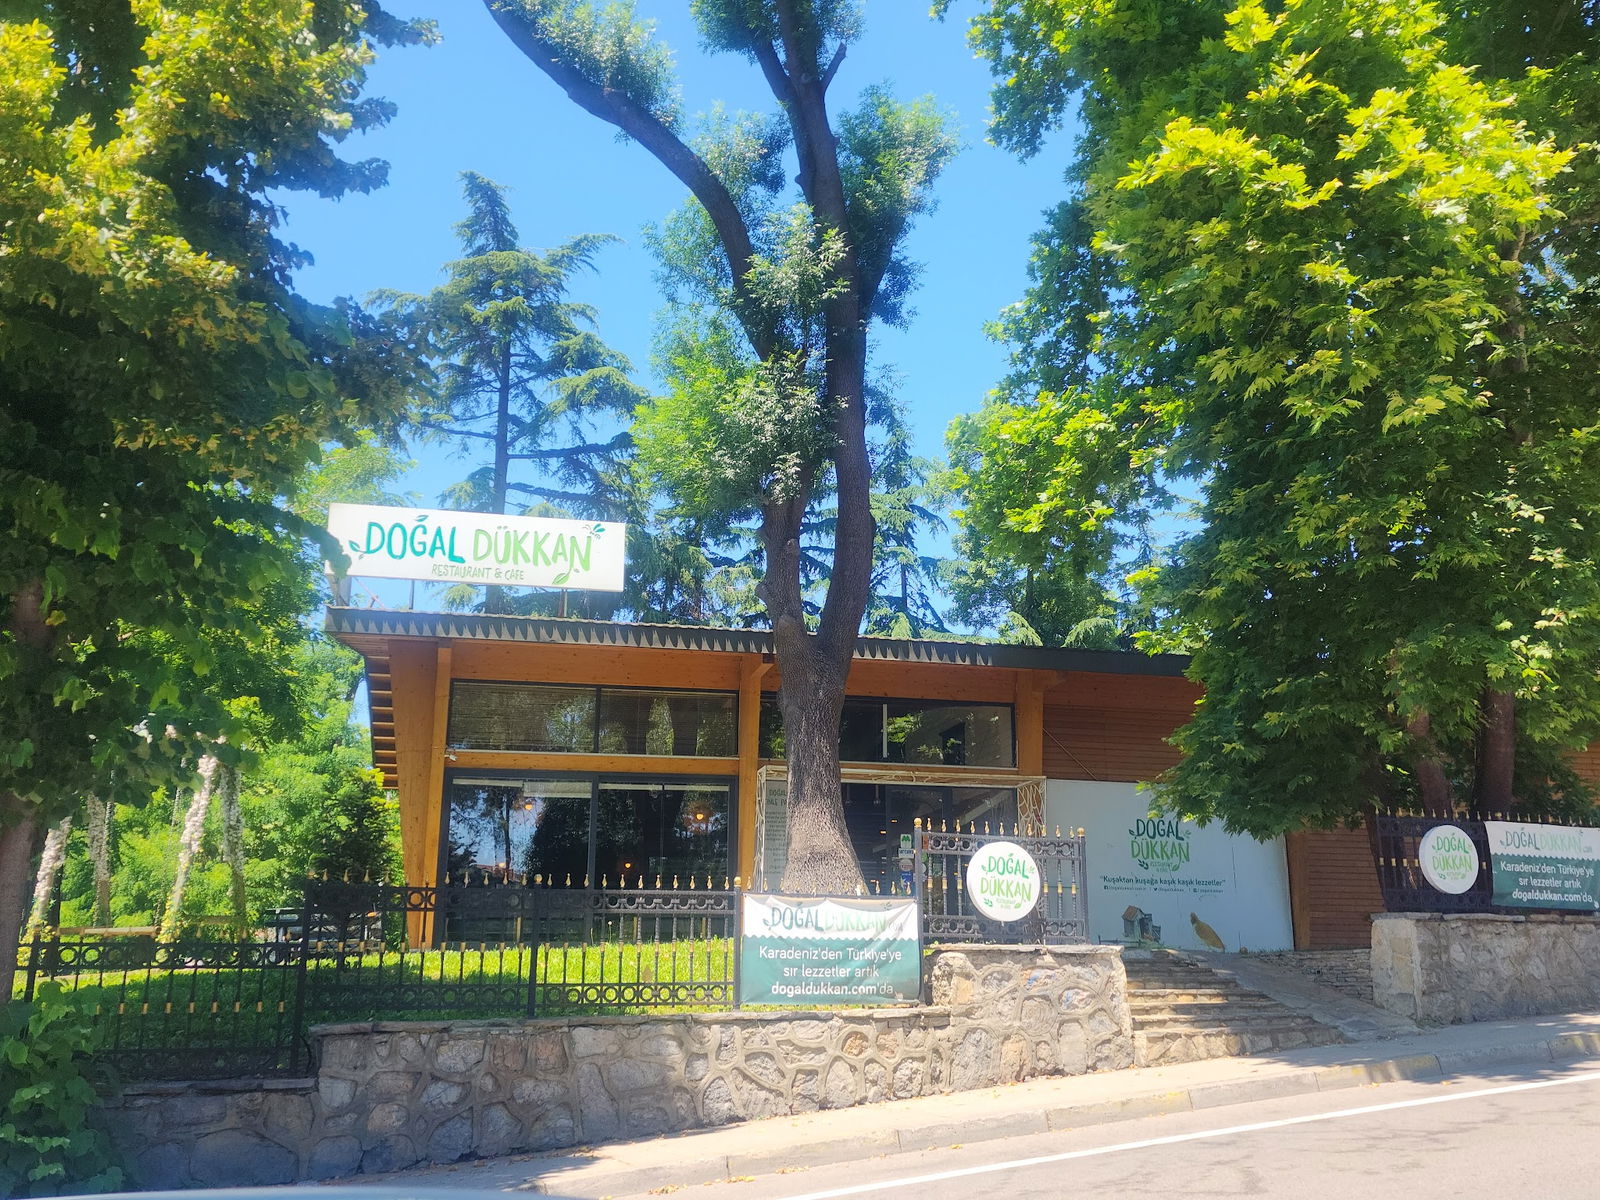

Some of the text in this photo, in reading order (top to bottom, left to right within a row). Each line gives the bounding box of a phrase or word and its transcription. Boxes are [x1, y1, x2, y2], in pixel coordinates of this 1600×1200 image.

[365, 515, 593, 573] DOĞAL DÜKKAN
[431, 564, 525, 581] RESTAURANT & CAFE
[1131, 838, 1190, 862] DÜKKAN
[1436, 833, 1469, 853] DOĞAL
[987, 853, 1029, 879] DOĞAL
[1432, 854, 1473, 872] DÜKKAN
[1500, 860, 1556, 874] Karadeniz'den
[980, 876, 1032, 902] DÜKKAN
[759, 946, 902, 963] Karadeniz'den Türkiye'ye
[783, 965, 880, 977] sır lezzetler artık
[771, 981, 893, 998] dogaldukkan.com'da
